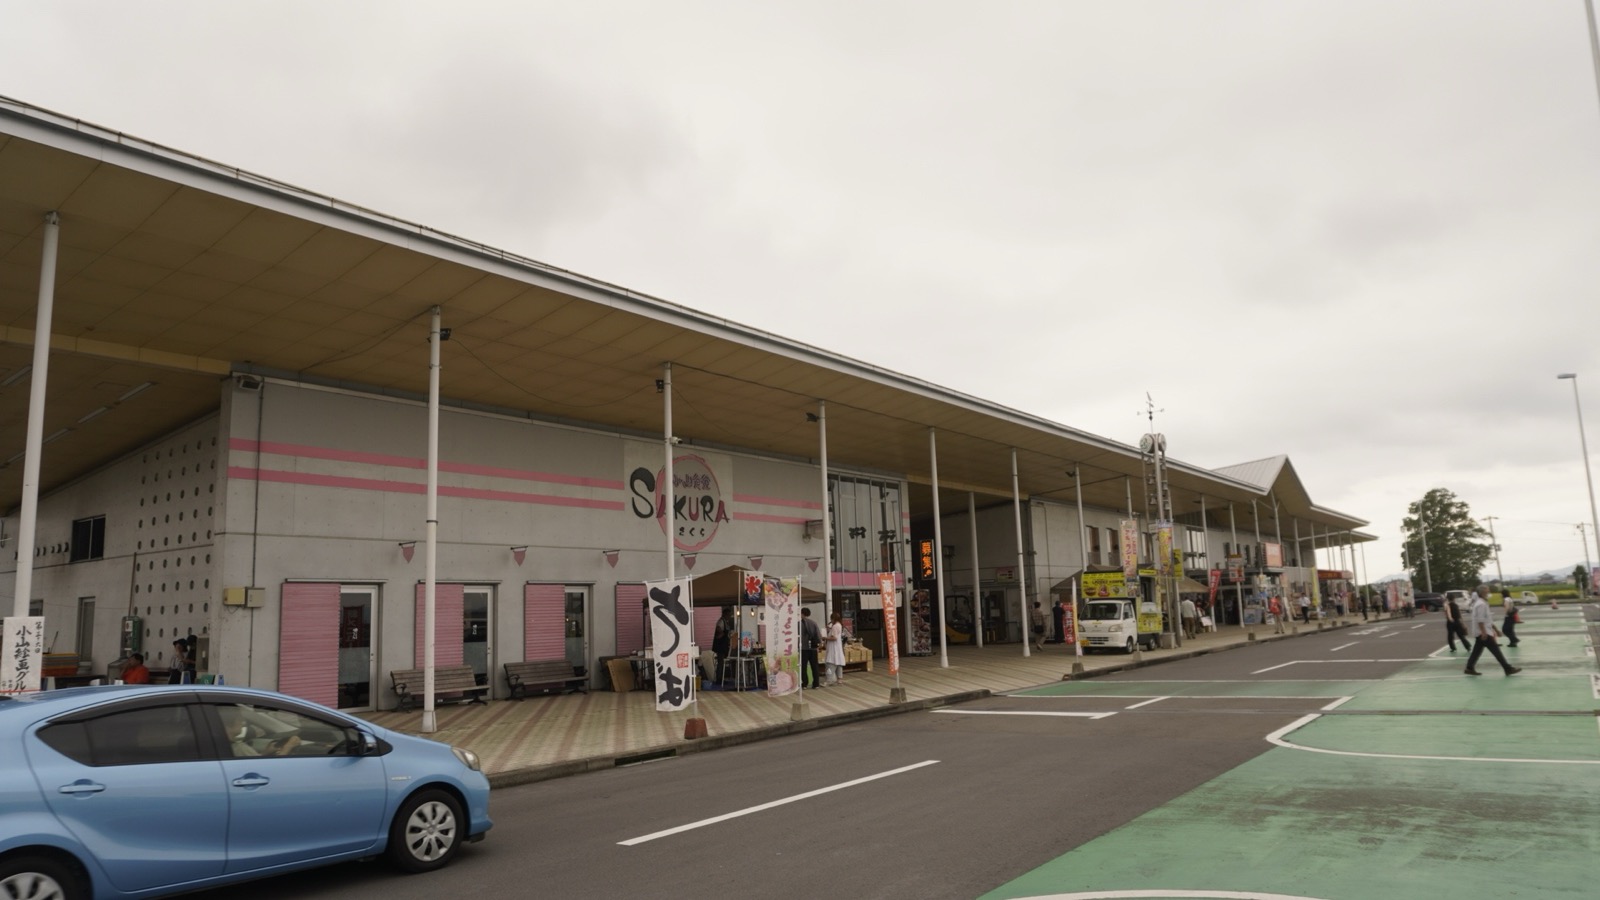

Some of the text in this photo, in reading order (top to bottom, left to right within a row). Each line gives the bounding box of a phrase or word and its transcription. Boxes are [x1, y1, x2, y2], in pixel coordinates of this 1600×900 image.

[630, 467, 730, 523] SAKURA
[679, 527, 705, 537] さくら
[745, 575, 761, 596] 氷
